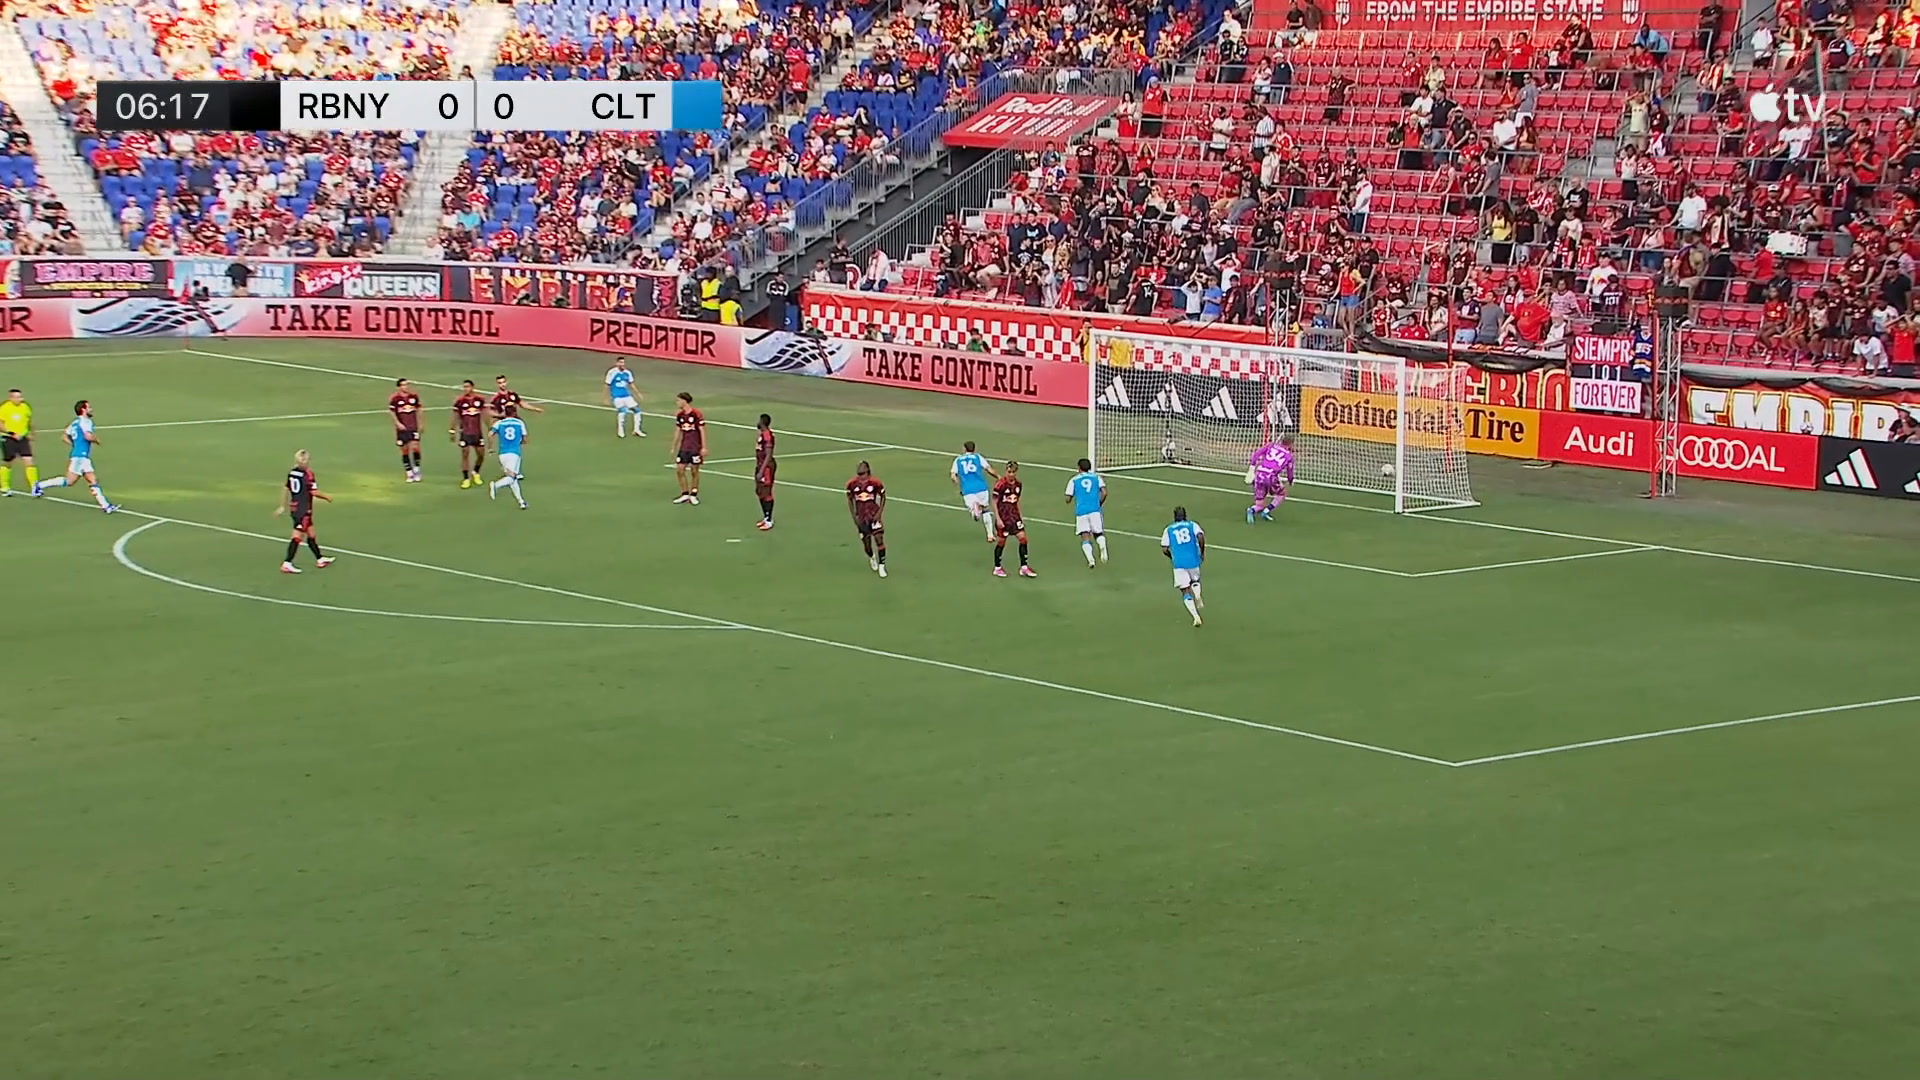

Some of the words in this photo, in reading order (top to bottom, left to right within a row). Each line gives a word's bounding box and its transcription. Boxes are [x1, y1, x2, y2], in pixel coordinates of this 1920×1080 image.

[1366, 0, 1415, 21] FROM
[1422, 0, 1458, 21] THE
[1465, 0, 1535, 21] EMPIRE
[1541, 0, 1604, 21] STATE
[996, 97, 1058, 115] Red
[966, 114, 1024, 134] NEW
[34, 262, 154, 283] EMPIRE
[343, 275, 437, 298] QUEENS
[469, 267, 637, 312] EMPIRE
[265, 304, 352, 332] TAKE
[364, 306, 499, 338] CONTROL
[590, 317, 715, 358] PREDATOR
[1574, 336, 1634, 363] SIEMPR
[863, 347, 923, 383] TAKE
[931, 354, 1038, 396] CONTROL
[1574, 382, 1637, 409] FOREVER
[1314, 394, 1463, 437] Continental
[1463, 408, 1524, 443] Tire
[1687, 386, 1920, 441] EMPIR
[504, 426, 517, 441] 8
[1563, 424, 1634, 458] Audi
[960, 460, 978, 475] 16
[1265, 447, 1287, 467] 34
[1081, 478, 1093, 493] 9
[1172, 527, 1192, 545] 18
